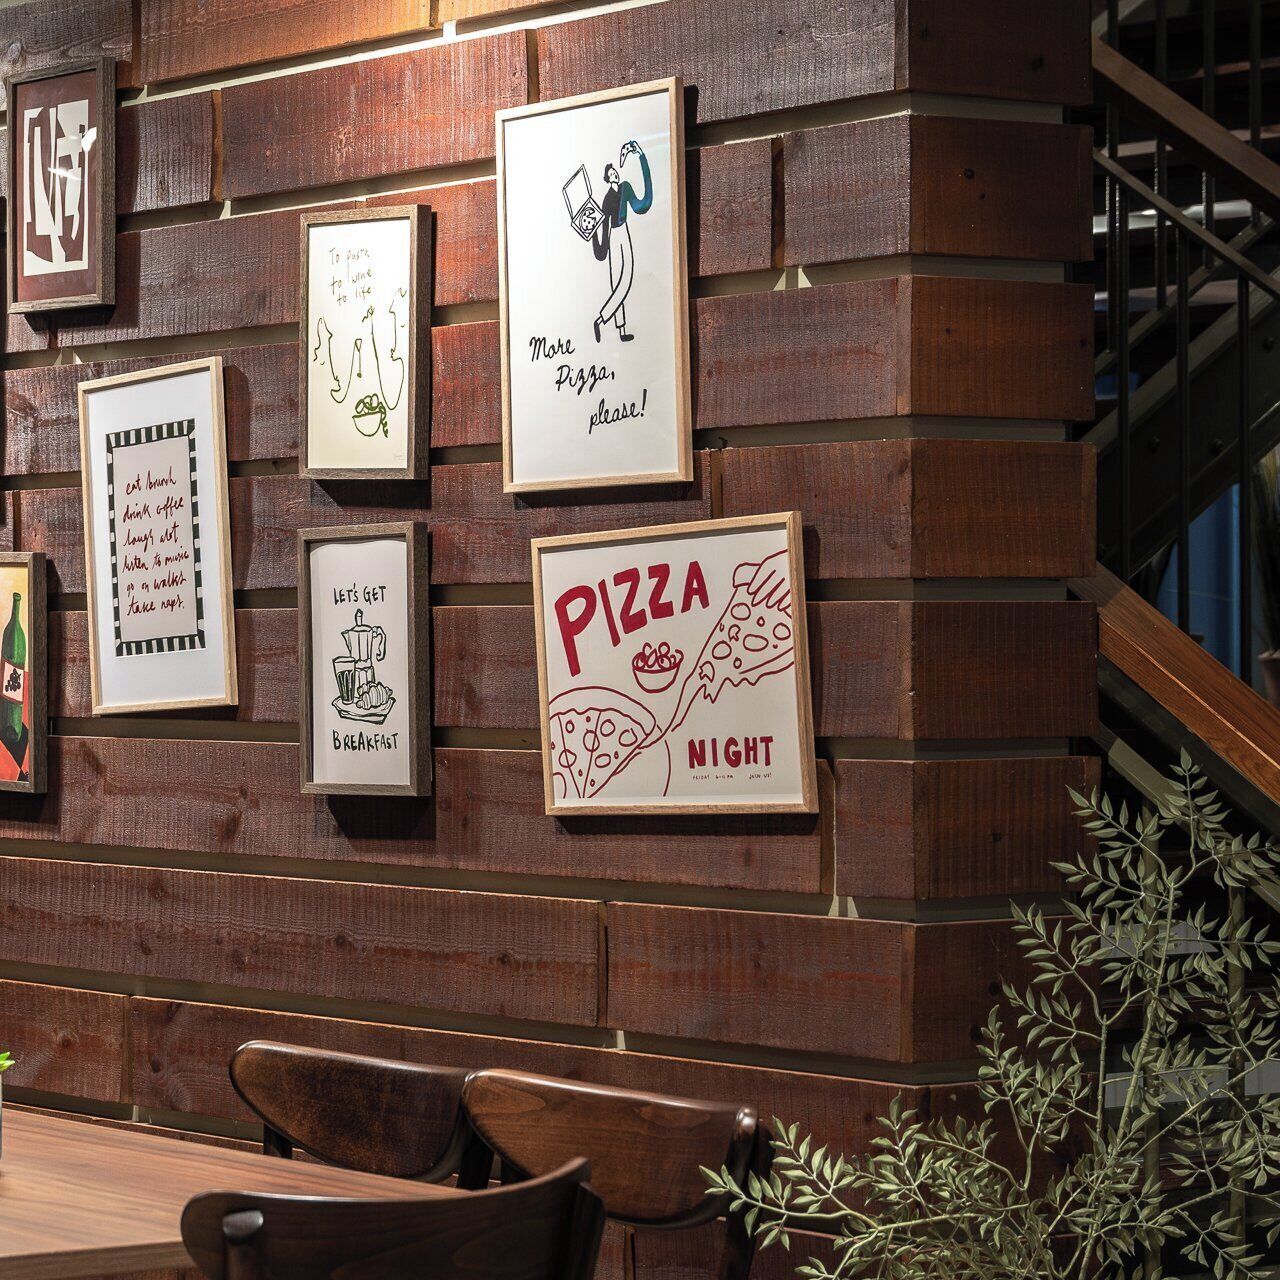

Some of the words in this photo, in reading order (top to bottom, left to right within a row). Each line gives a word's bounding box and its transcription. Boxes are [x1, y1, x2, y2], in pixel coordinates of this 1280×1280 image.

[331, 275, 342, 296] to
[352, 269, 371, 284] wine
[337, 292, 347, 307] to
[356, 285, 371, 300] life
[529, 336, 575, 362] More
[555, 364, 615, 396] Pizza,
[588, 388, 648, 434] please!
[126, 473, 141, 495] eat
[146, 465, 176, 490] brunch
[123, 503, 151, 523] drink
[157, 495, 184, 520] coffee
[123, 528, 153, 553] laugh
[122, 552, 148, 573] listen
[152, 552, 161, 570] to
[165, 546, 189, 566] music
[127, 583, 134, 598] go
[142, 582, 149, 592] on
[154, 570, 187, 590] walks
[333, 582, 359, 605] LET'S
[363, 585, 387, 606] GET
[127, 595, 156, 616] take
[554, 561, 710, 677] PIZZA
[333, 729, 399, 752] BREAKFAST
[688, 735, 774, 769] NIGHT
